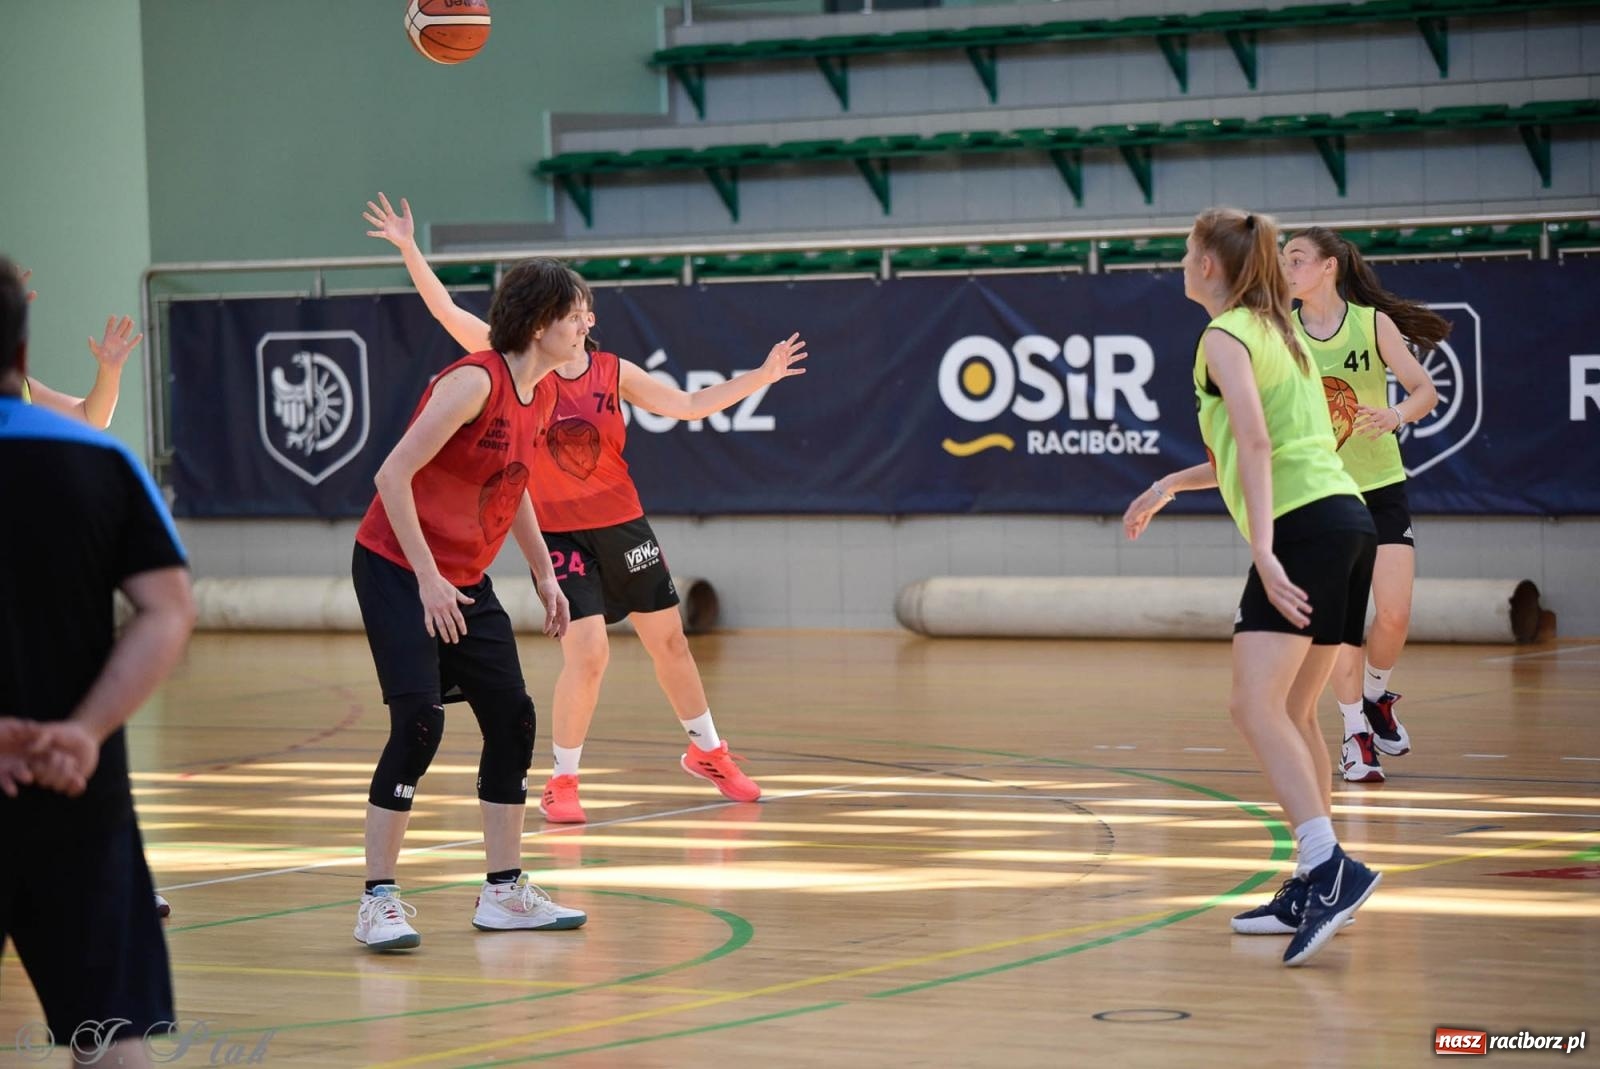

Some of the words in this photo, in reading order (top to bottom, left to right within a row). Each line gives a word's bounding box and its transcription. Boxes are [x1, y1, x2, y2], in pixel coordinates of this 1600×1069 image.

[1343, 349, 1370, 372] 41
[938, 334, 1160, 422] OSiR
[592, 392, 616, 415] 74
[1027, 424, 1160, 454] RACIBÓRZ
[550, 551, 586, 581] 24
[626, 542, 652, 568] VBW
[401, 784, 415, 799] NB
